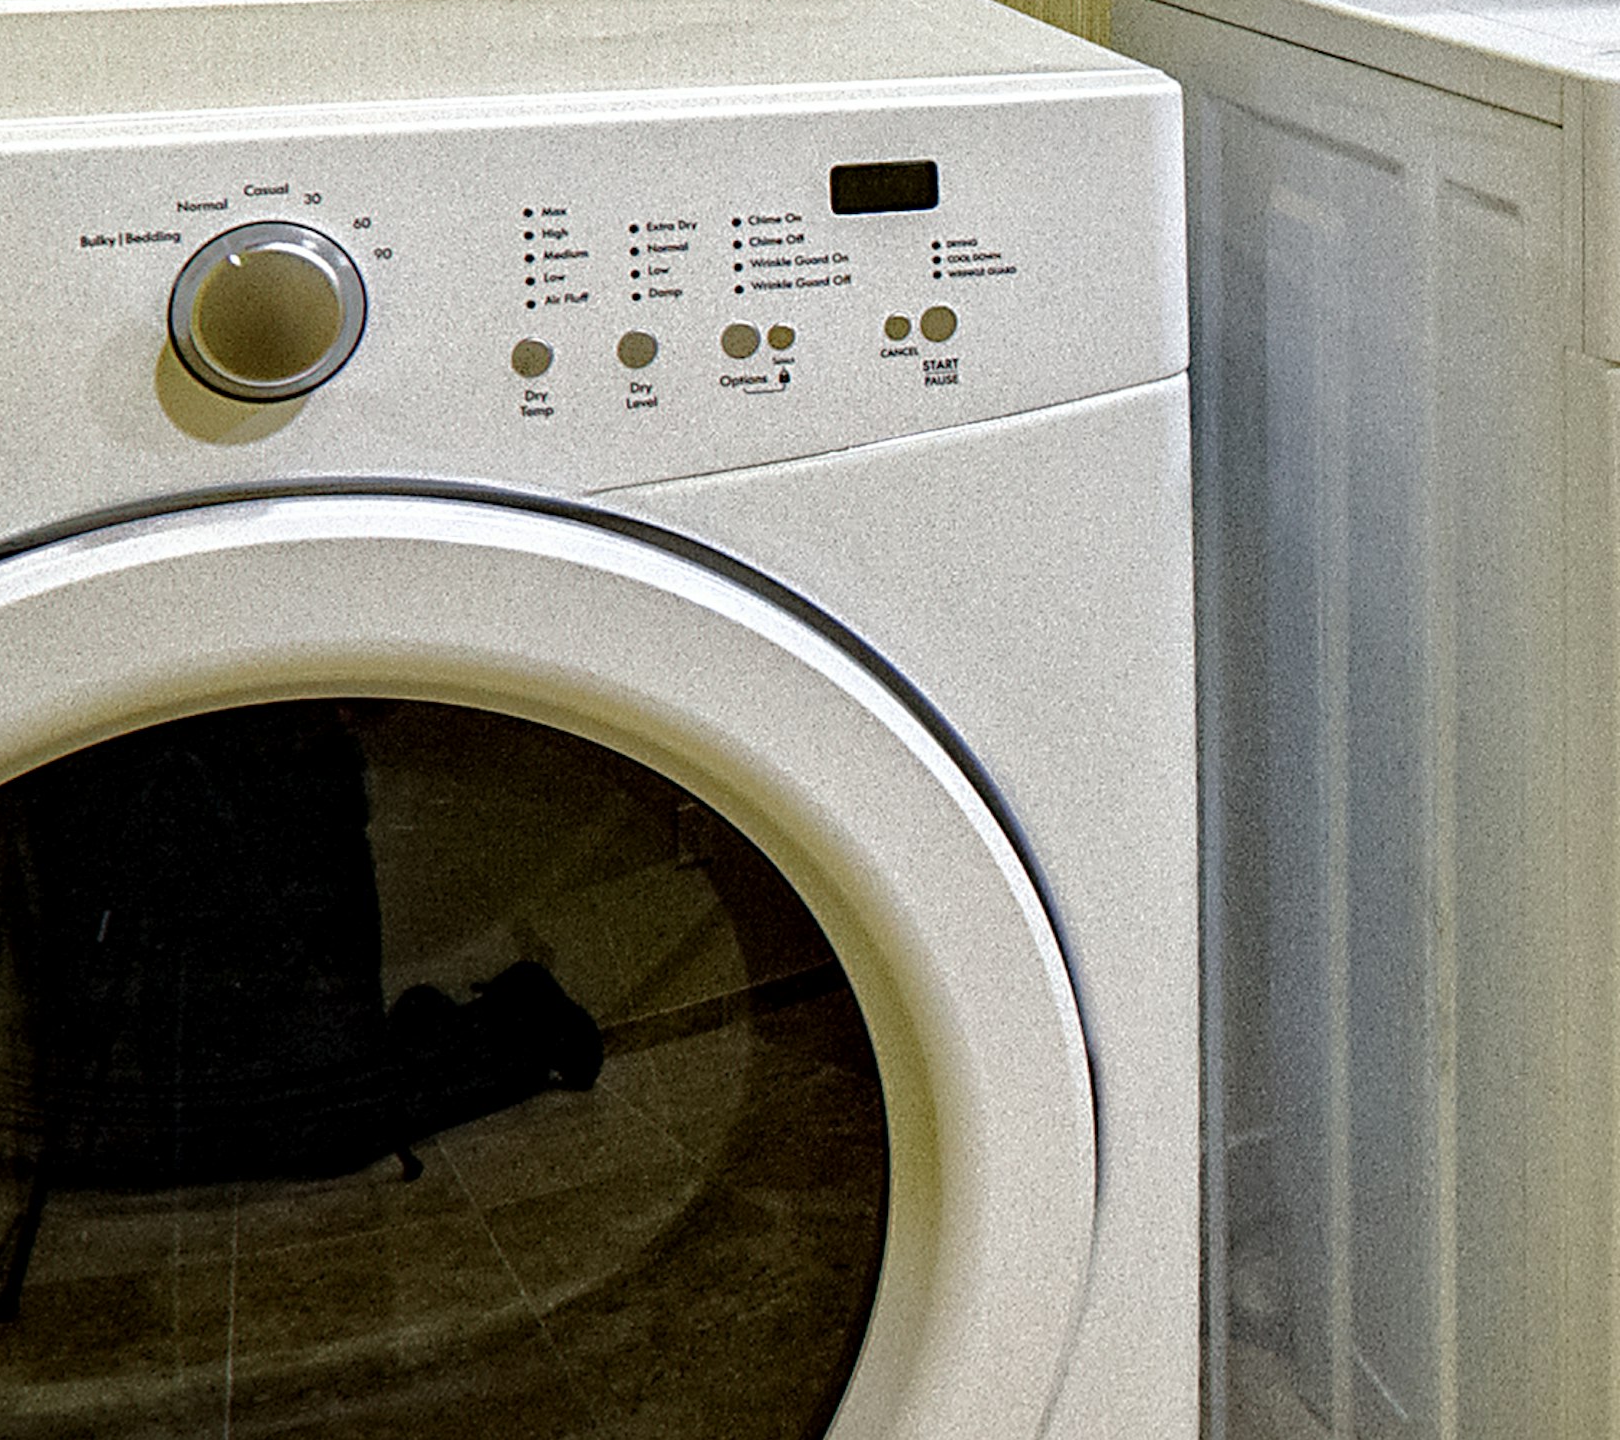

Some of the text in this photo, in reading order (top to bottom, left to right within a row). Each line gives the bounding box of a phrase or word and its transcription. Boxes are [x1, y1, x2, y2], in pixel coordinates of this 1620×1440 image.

[244, 184, 289, 197] Casual
[304, 193, 321, 205] 30
[177, 198, 228, 213] Normal
[541, 207, 566, 217] Max
[353, 217, 371, 229] 60
[748, 213, 802, 226] Chime On
[646, 220, 697, 232] Extra Dry
[80, 236, 116, 248] Bulky
[125, 232, 181, 244] Bedding
[542, 228, 568, 240] High
[749, 233, 804, 247] Chime Off
[647, 242, 688, 253] Normal
[374, 248, 392, 260] 90
[544, 250, 589, 260] Medium
[750, 252, 849, 268] Wrinkle Guard On
[648, 265, 670, 276] Low
[544, 272, 565, 283] Low
[751, 274, 851, 290] Wrinkle Guard Off
[545, 292, 588, 305] Air Fluff
[648, 288, 683, 299] Damp
[880, 347, 919, 358] CANCEL
[922, 358, 959, 372] START
[720, 375, 768, 388] Options
[924, 374, 958, 387] PAUSE
[630, 382, 652, 394] Dry
[524, 390, 548, 402] Dry
[626, 395, 658, 409] Level
[520, 405, 554, 418] Temp
